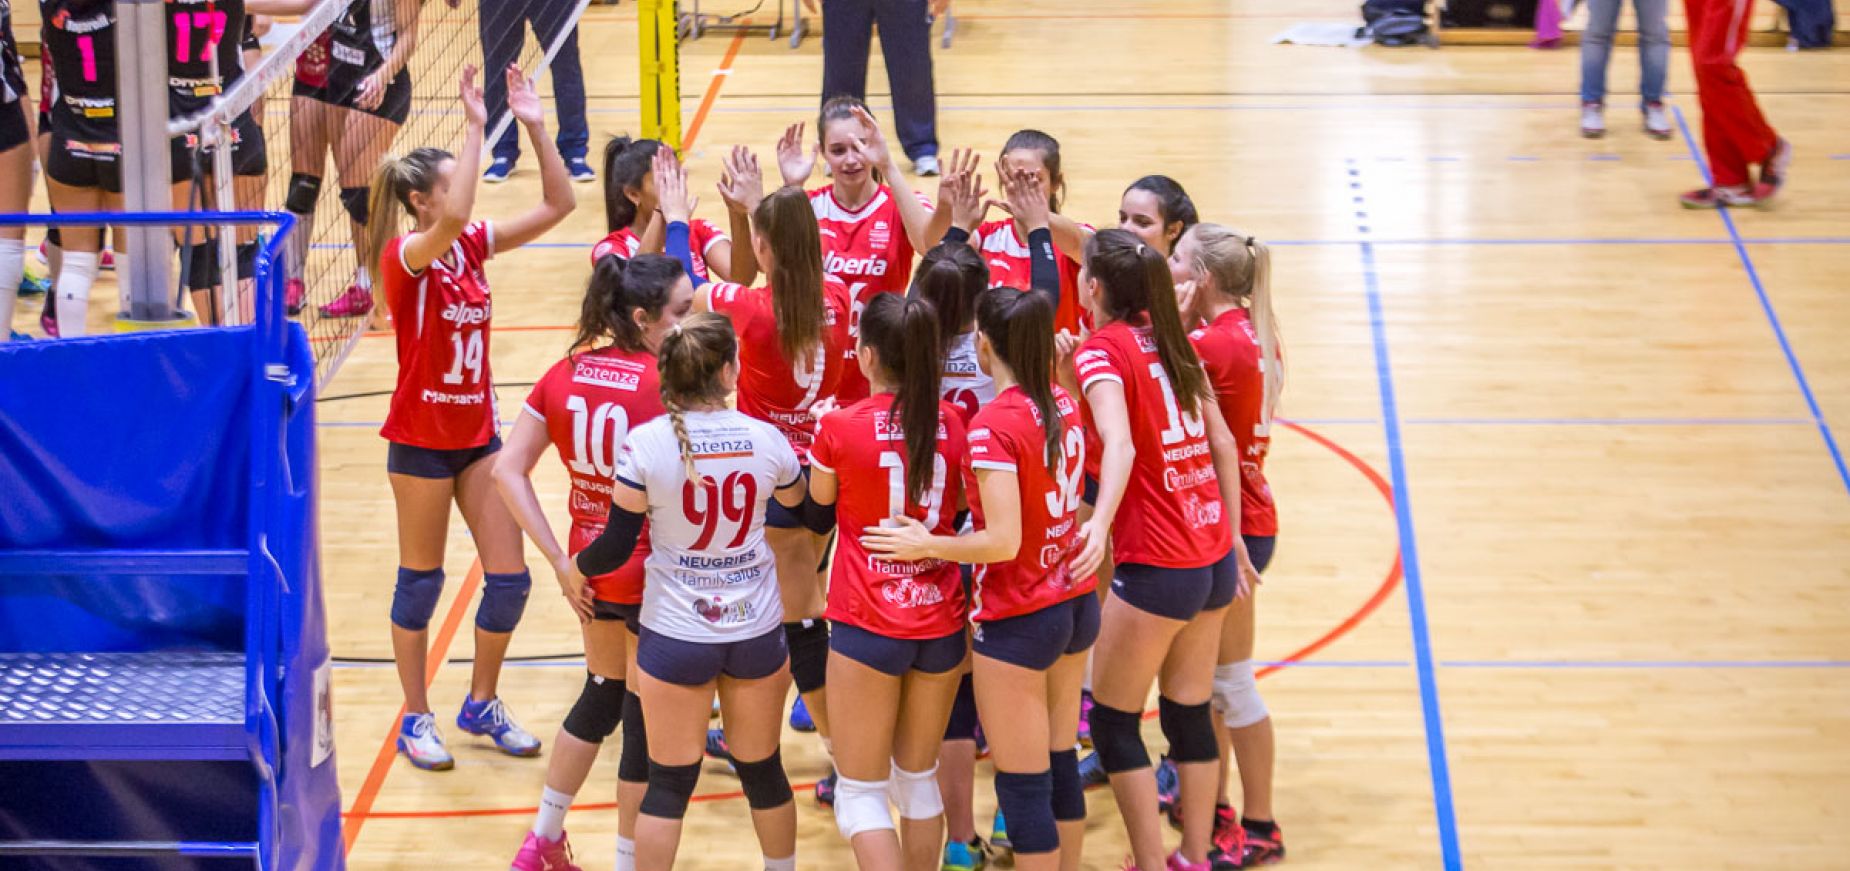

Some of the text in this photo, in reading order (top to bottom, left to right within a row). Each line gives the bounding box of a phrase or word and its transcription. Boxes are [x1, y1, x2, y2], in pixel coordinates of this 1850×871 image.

[76, 35, 97, 82] 1
[173, 11, 228, 63] 17
[823, 250, 887, 276] lperia
[443, 329, 484, 385] 14
[575, 362, 640, 385] Potenza
[565, 395, 628, 478] 10
[1043, 425, 1085, 518] 32
[682, 470, 757, 550] 99
[678, 566, 760, 588] familysalus
[680, 549, 756, 570] NEUGRIES
